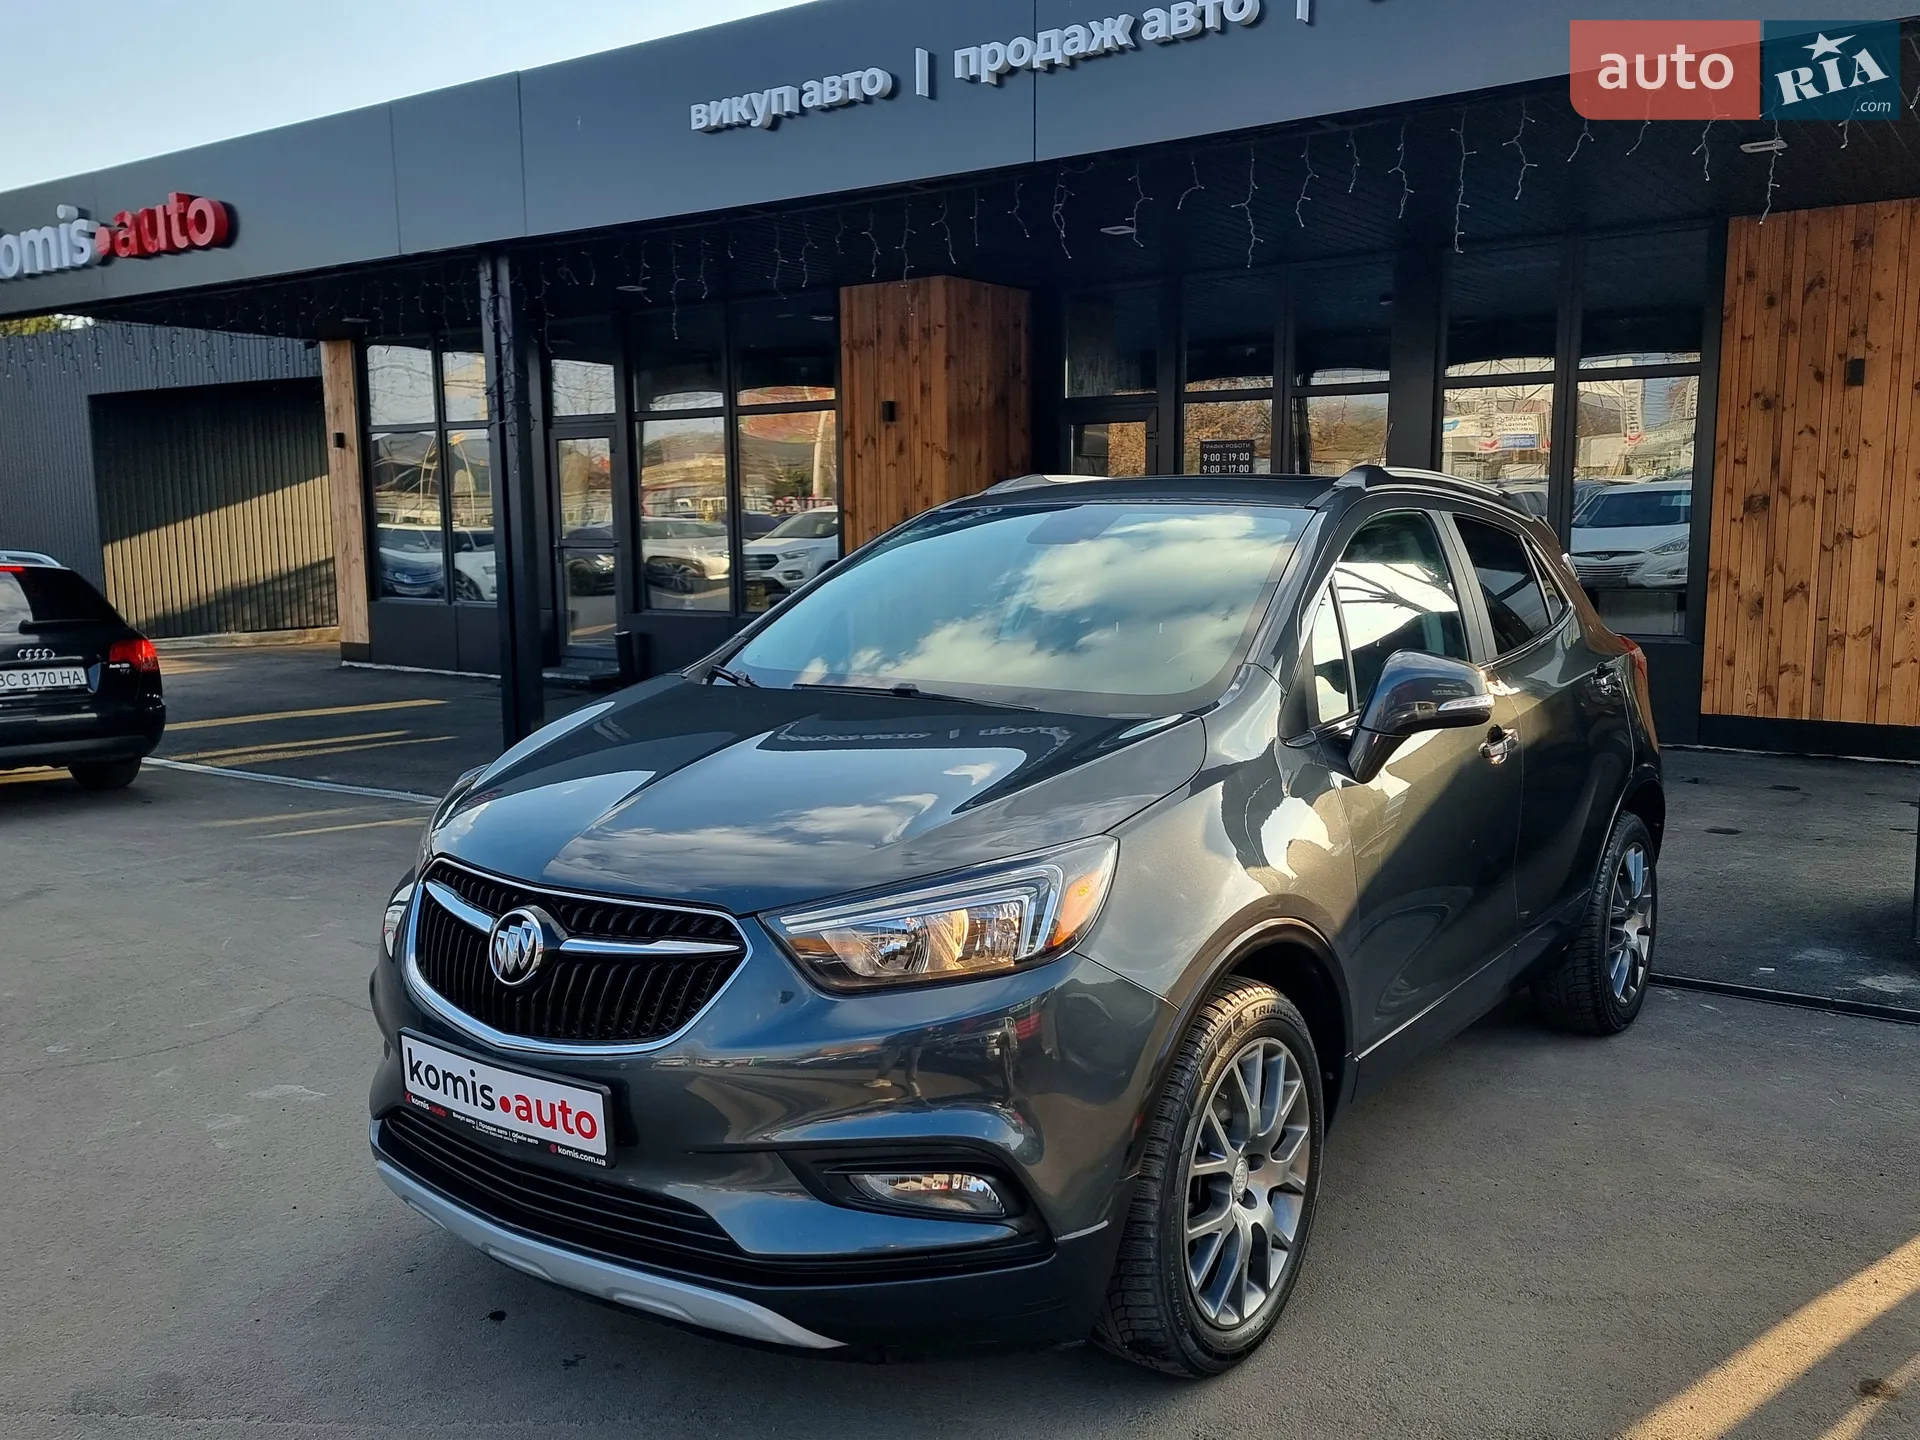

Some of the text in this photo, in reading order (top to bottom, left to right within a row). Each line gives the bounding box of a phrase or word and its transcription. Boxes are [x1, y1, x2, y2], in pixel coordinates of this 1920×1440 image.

[690, 0, 1259, 129] викуп авто продаж авто
[0, 204, 99, 279] omis
[1203, 453, 1250, 462] 9:00 19:00
[1203, 464, 1249, 473] 9:00 17:00
[22, 672, 56, 686] 8170
[558, 1146, 606, 1166] komis.com.ua
